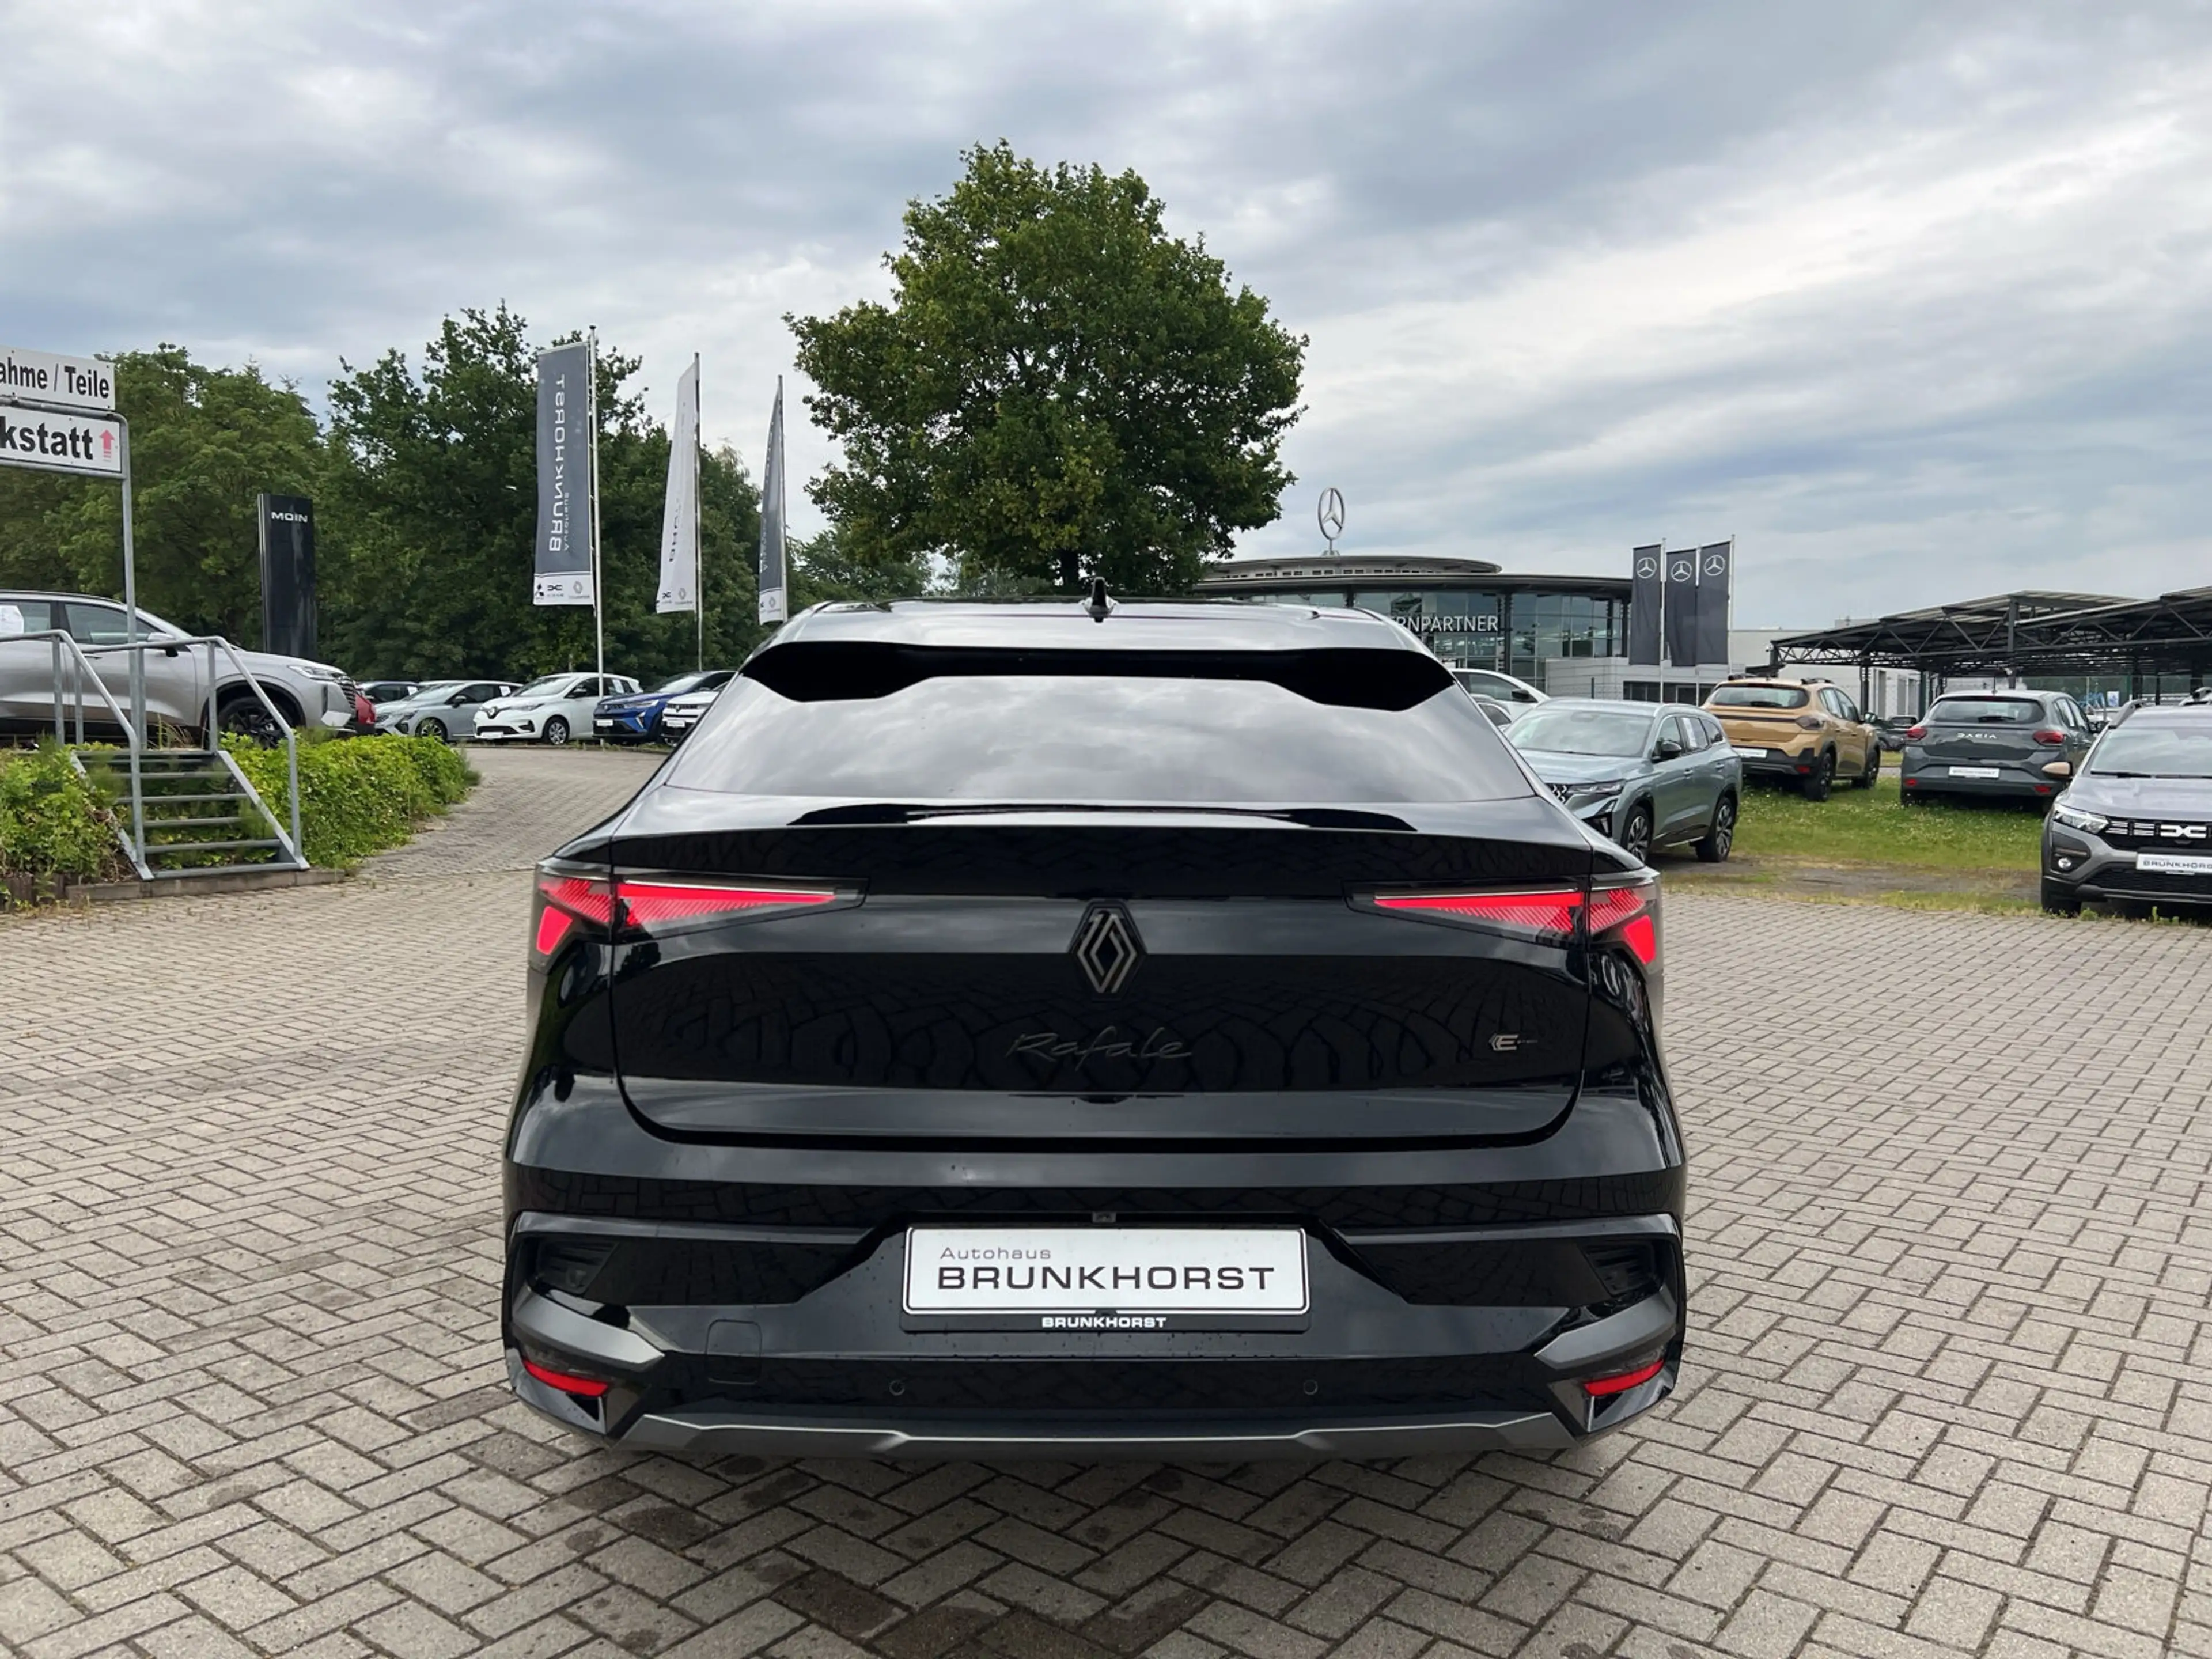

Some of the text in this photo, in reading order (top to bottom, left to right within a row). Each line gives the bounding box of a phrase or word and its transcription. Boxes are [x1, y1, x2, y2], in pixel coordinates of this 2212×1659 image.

[64, 366, 109, 399] Teile
[0, 416, 93, 460] kstatt
[271, 511, 308, 523] MOIN
[1392, 615, 1498, 632] RNPARTNER
[1005, 1025, 1192, 1071] Rafale
[940, 1247, 1051, 1259] Autohaus
[938, 1266, 1275, 1290] BRUNKHORST
[1042, 1317, 1167, 1328] BRUNKHORST
